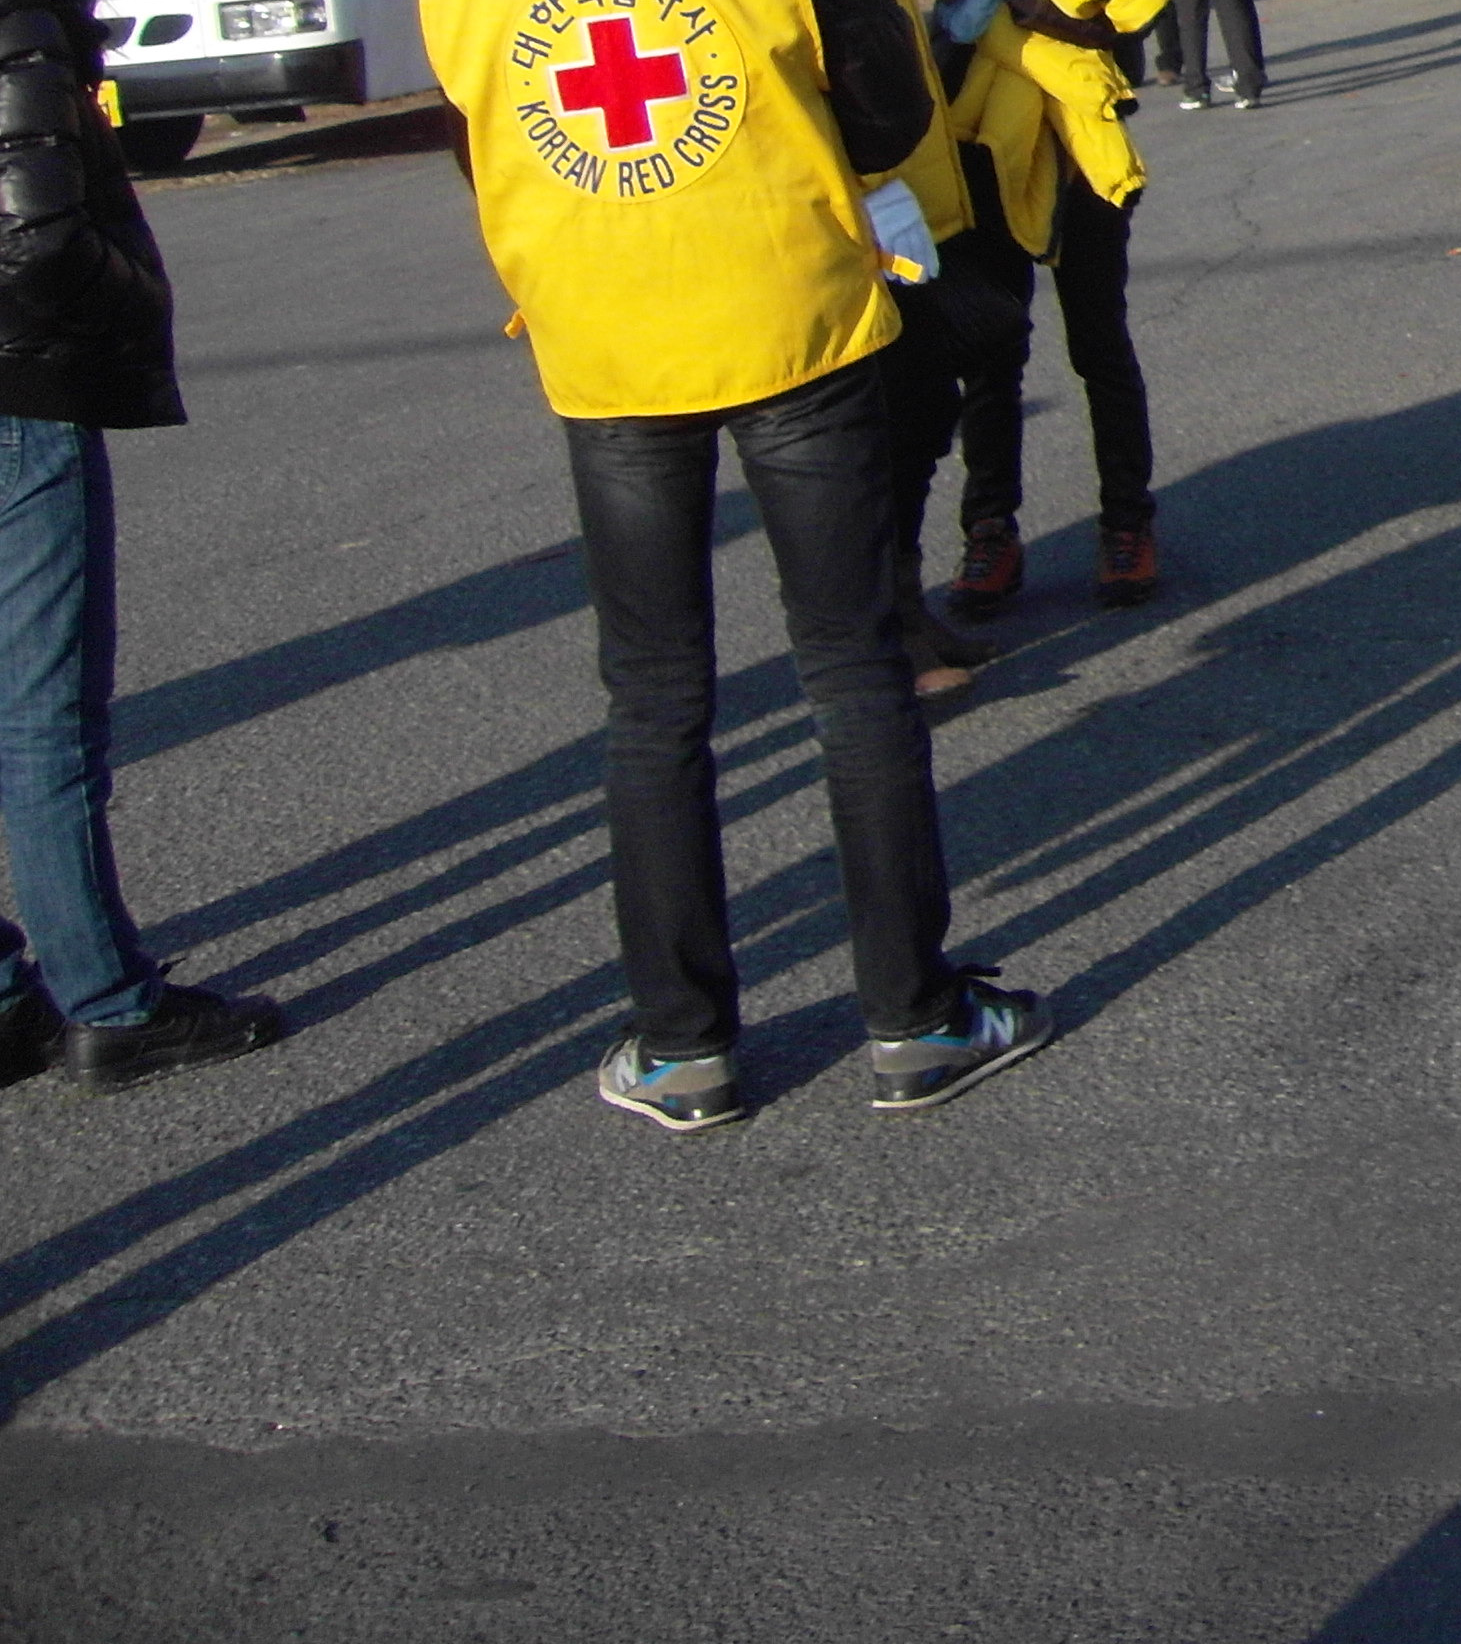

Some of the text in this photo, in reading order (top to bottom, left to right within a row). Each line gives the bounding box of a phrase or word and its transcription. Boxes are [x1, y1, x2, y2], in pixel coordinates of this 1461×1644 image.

[517, 73, 738, 197] KOREAN RED CROSS
